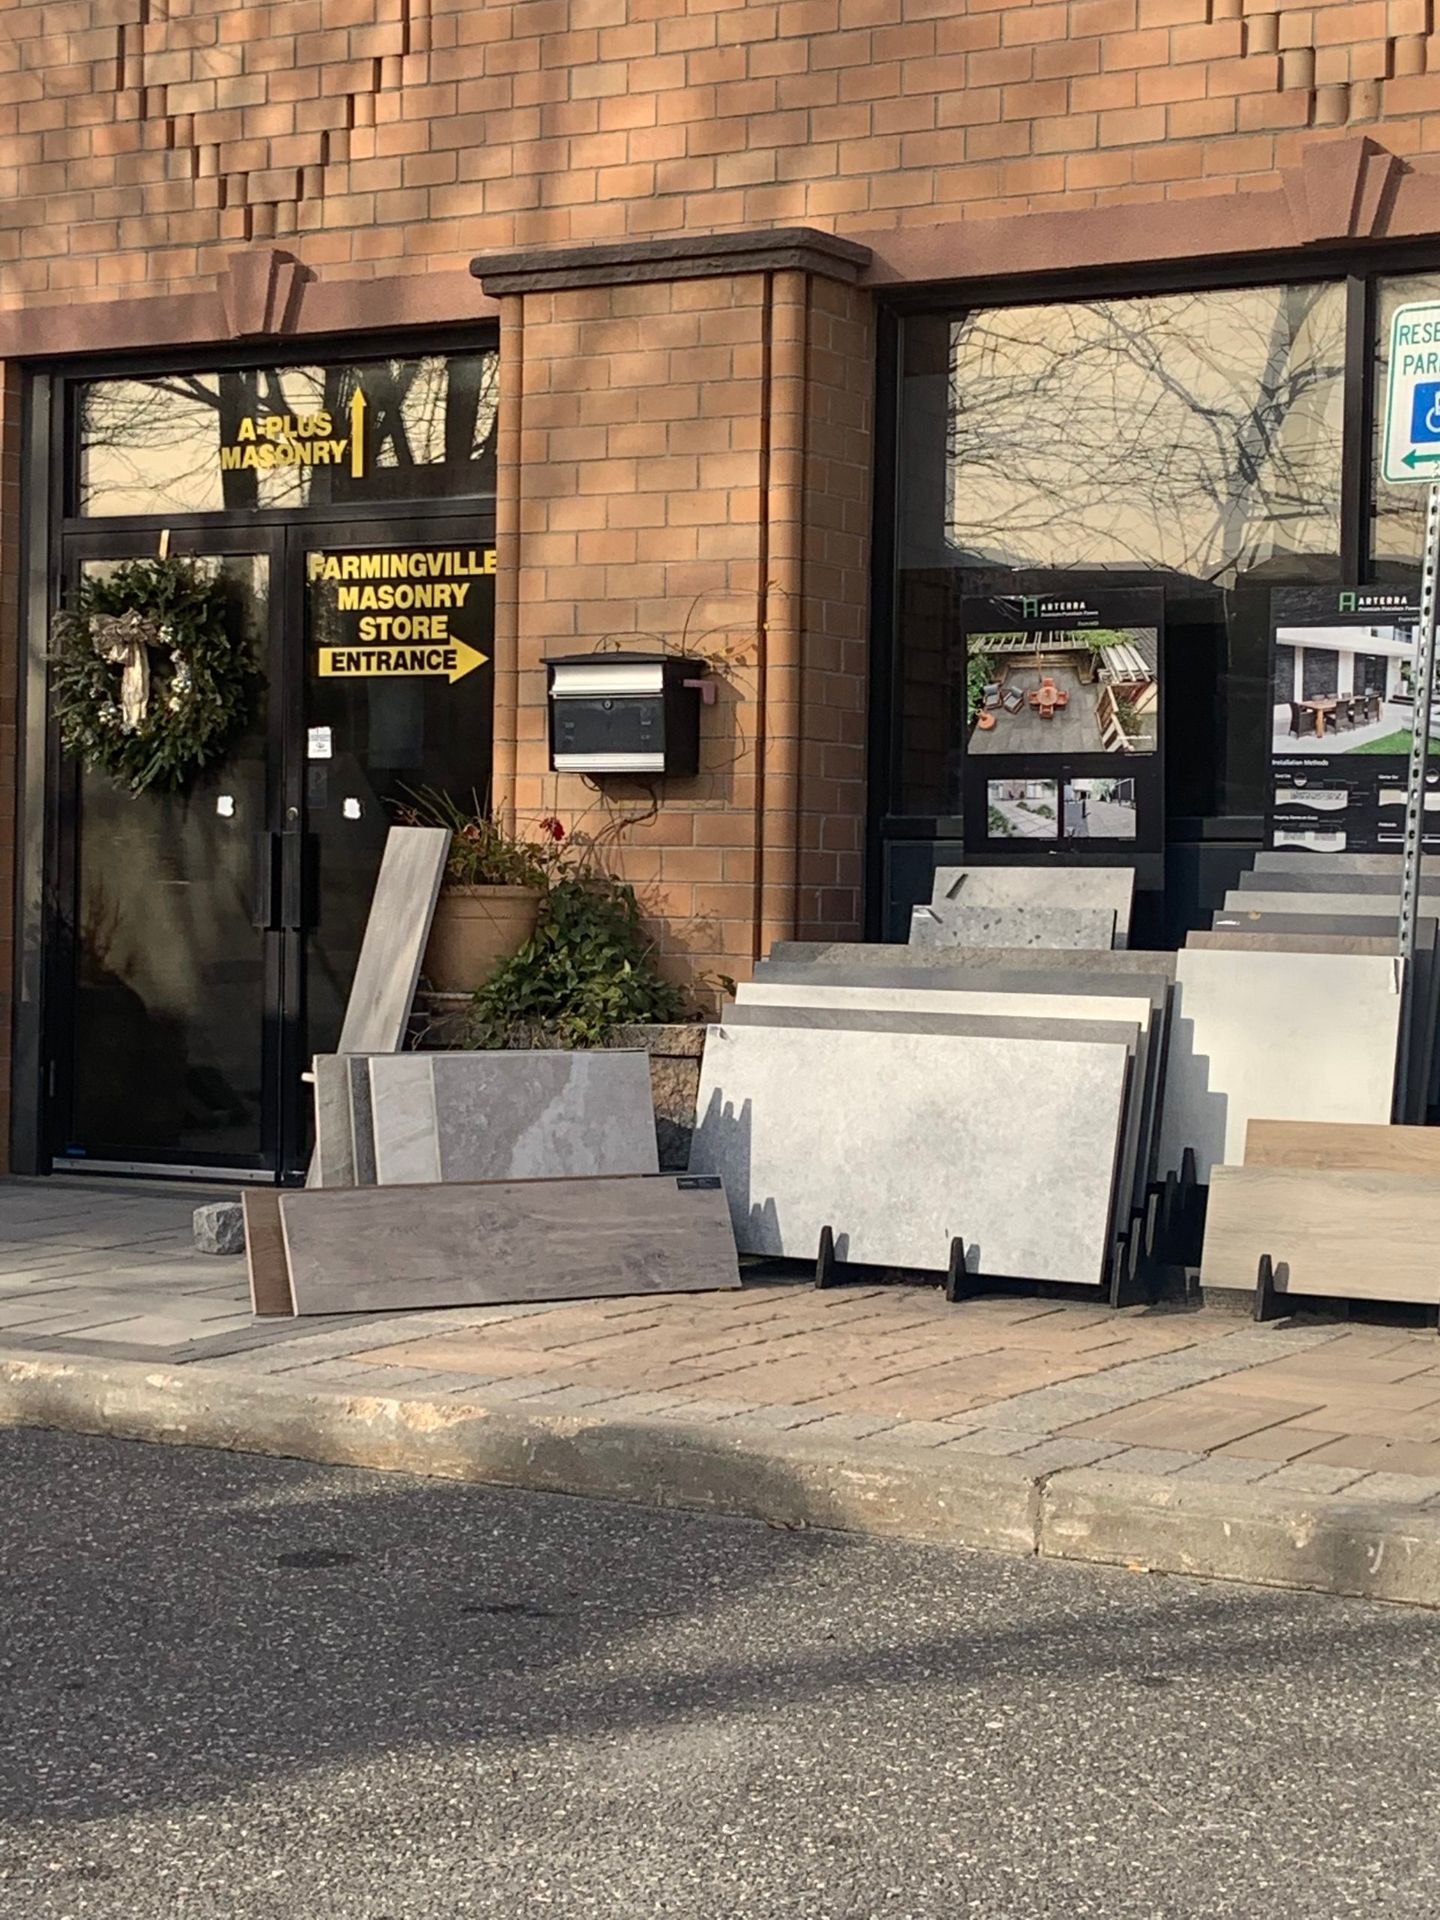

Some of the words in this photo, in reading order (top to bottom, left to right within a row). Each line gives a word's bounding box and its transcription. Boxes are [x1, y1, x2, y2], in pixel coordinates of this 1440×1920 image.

[1403, 352, 1440, 376] PAR
[237, 412, 332, 440] A-PLUS
[220, 440, 348, 470] MASONRY
[309, 550, 496, 580] FARMINGVILLE
[338, 583, 470, 611] MASONRY
[1358, 596, 1408, 606] ARTERRA
[359, 615, 448, 641] STORE
[331, 650, 457, 672] ENTRANCE
